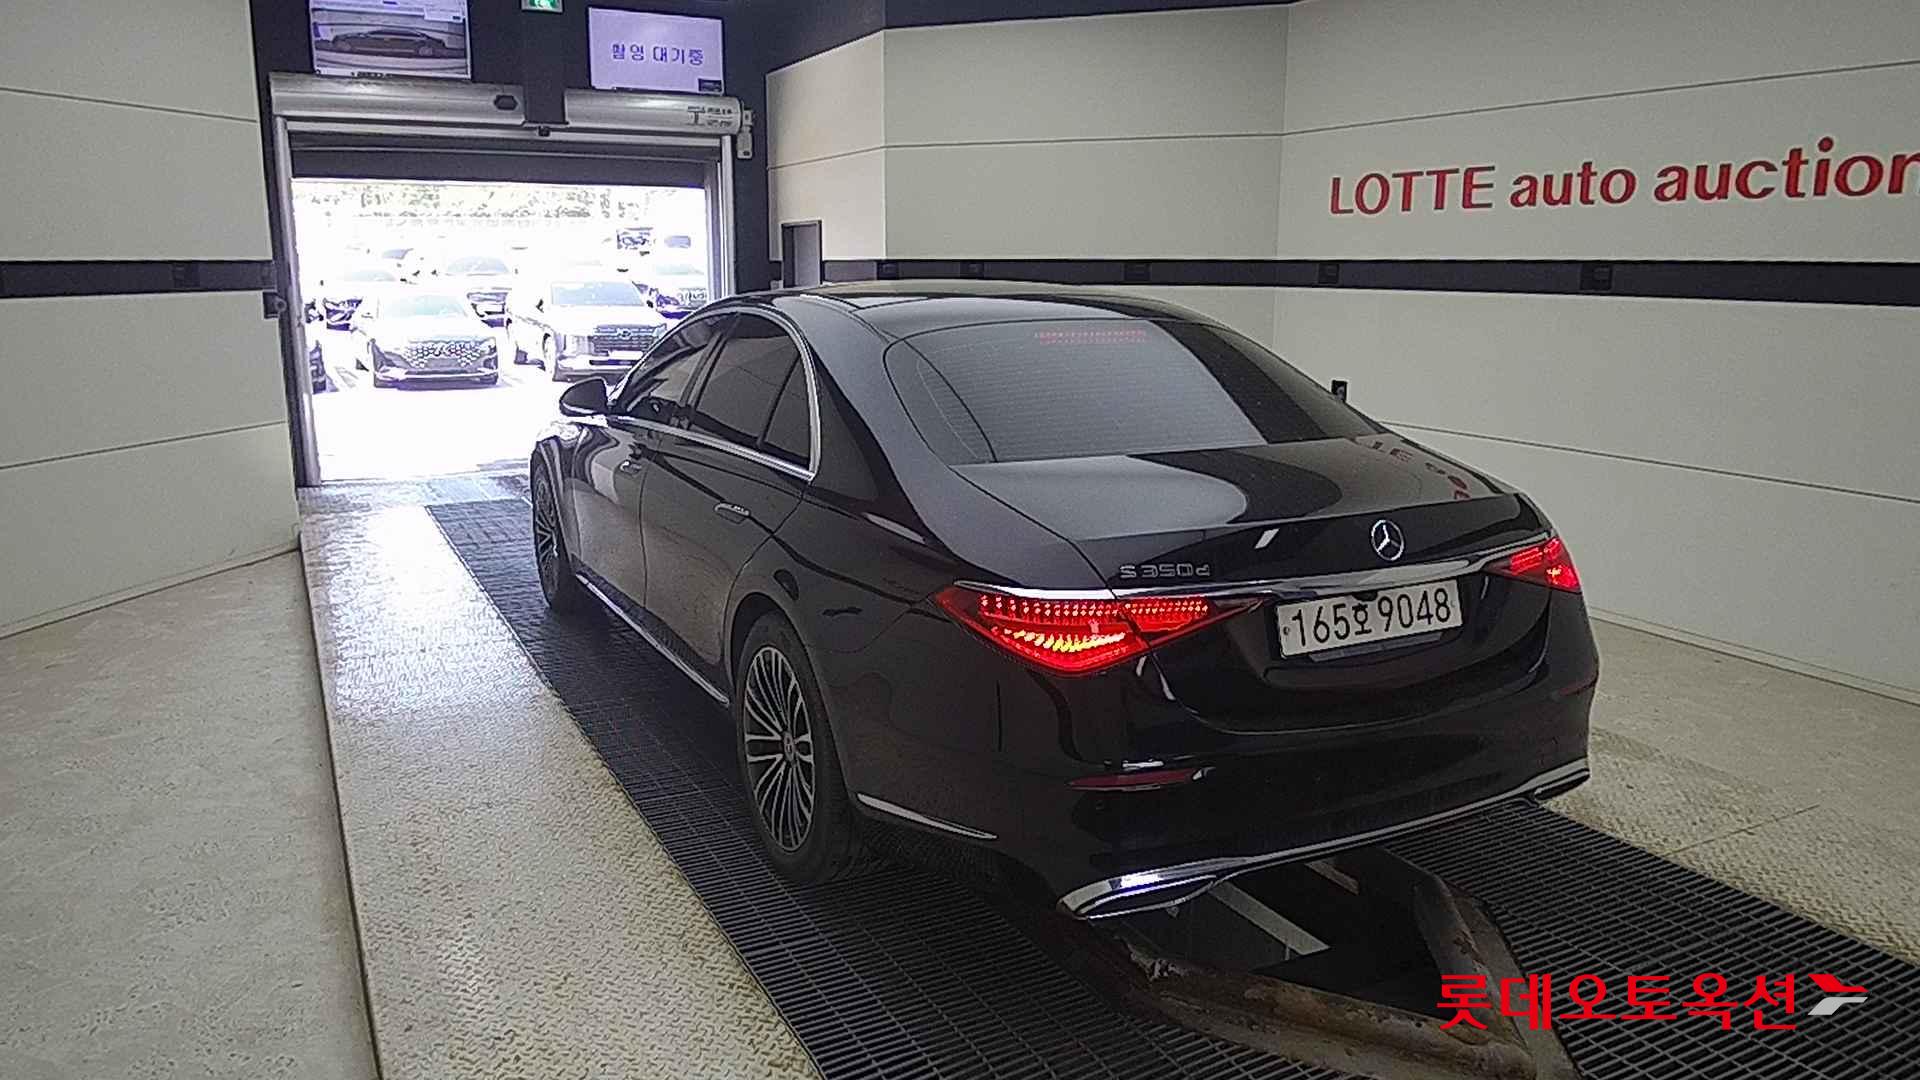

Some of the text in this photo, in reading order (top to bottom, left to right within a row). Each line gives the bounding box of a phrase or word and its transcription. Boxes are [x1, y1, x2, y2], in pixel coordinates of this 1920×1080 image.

[653, 46, 704, 66] 대기중
[1331, 165, 1497, 214] LOTTE
[1510, 162, 1637, 207] auto
